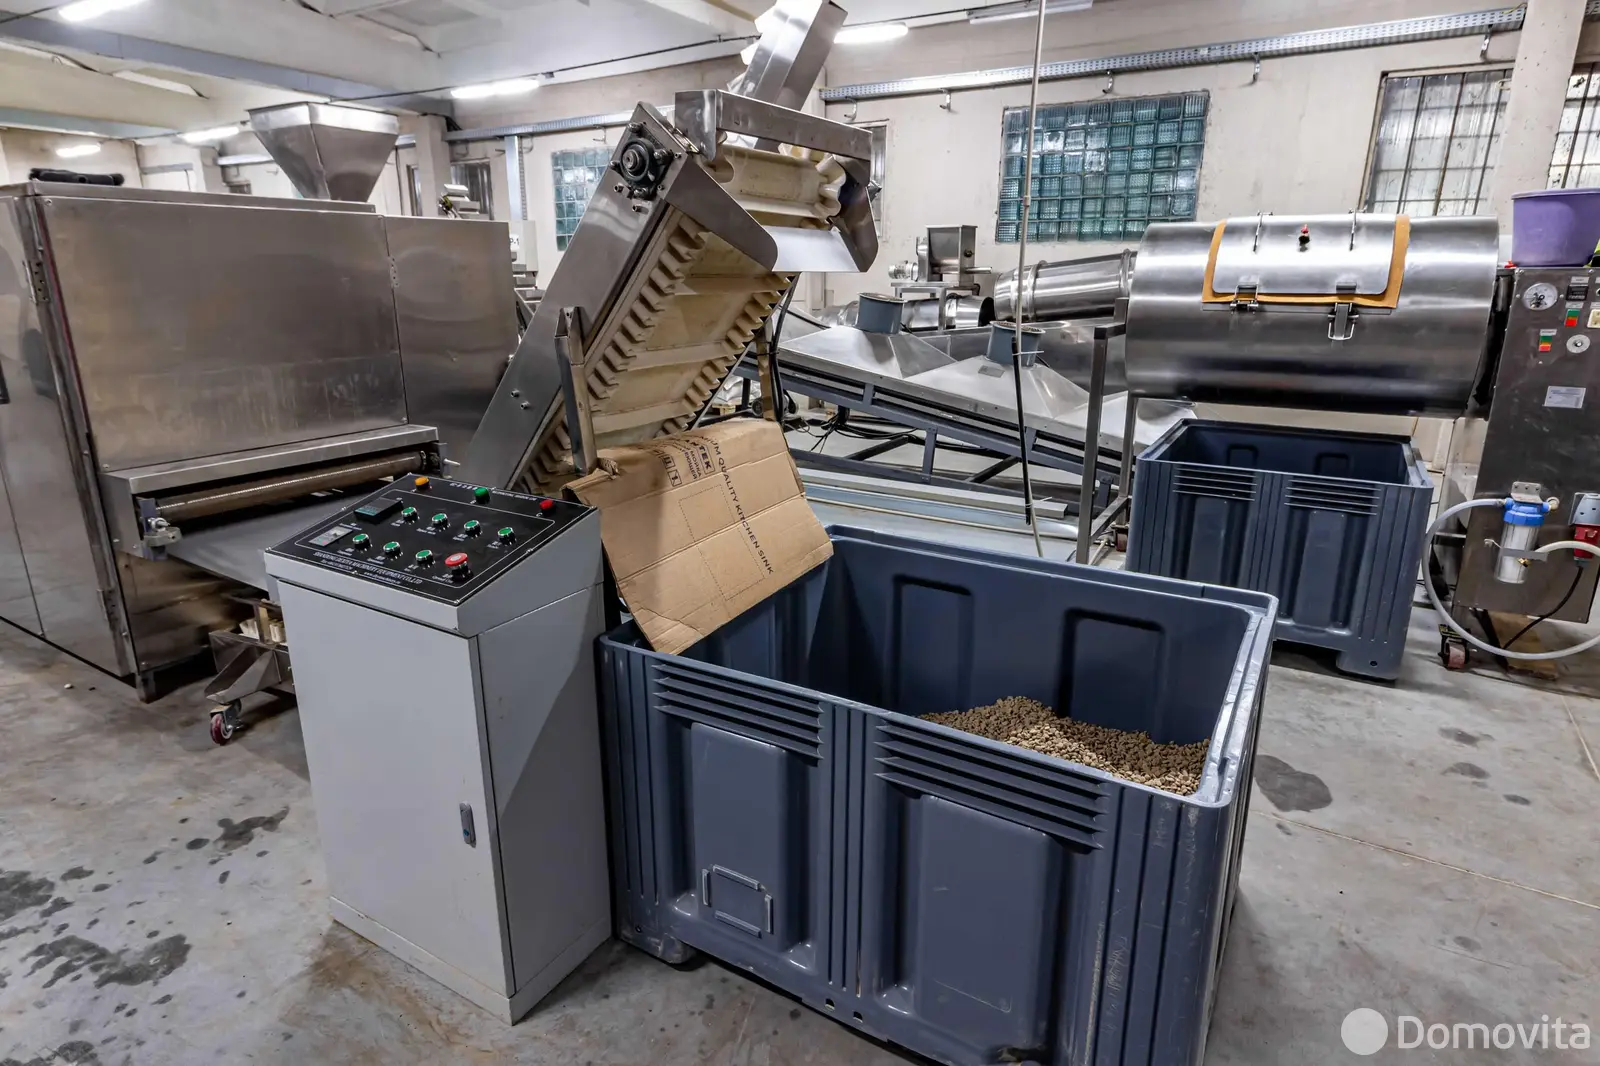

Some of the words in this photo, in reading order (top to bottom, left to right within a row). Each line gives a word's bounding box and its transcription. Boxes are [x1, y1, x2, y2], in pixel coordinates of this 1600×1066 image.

[689, 450, 702, 477] МОЙКА
[717, 457, 740, 502] QUALITY
[735, 504, 760, 550] KITCHEN
[757, 549, 774, 575] SINK
